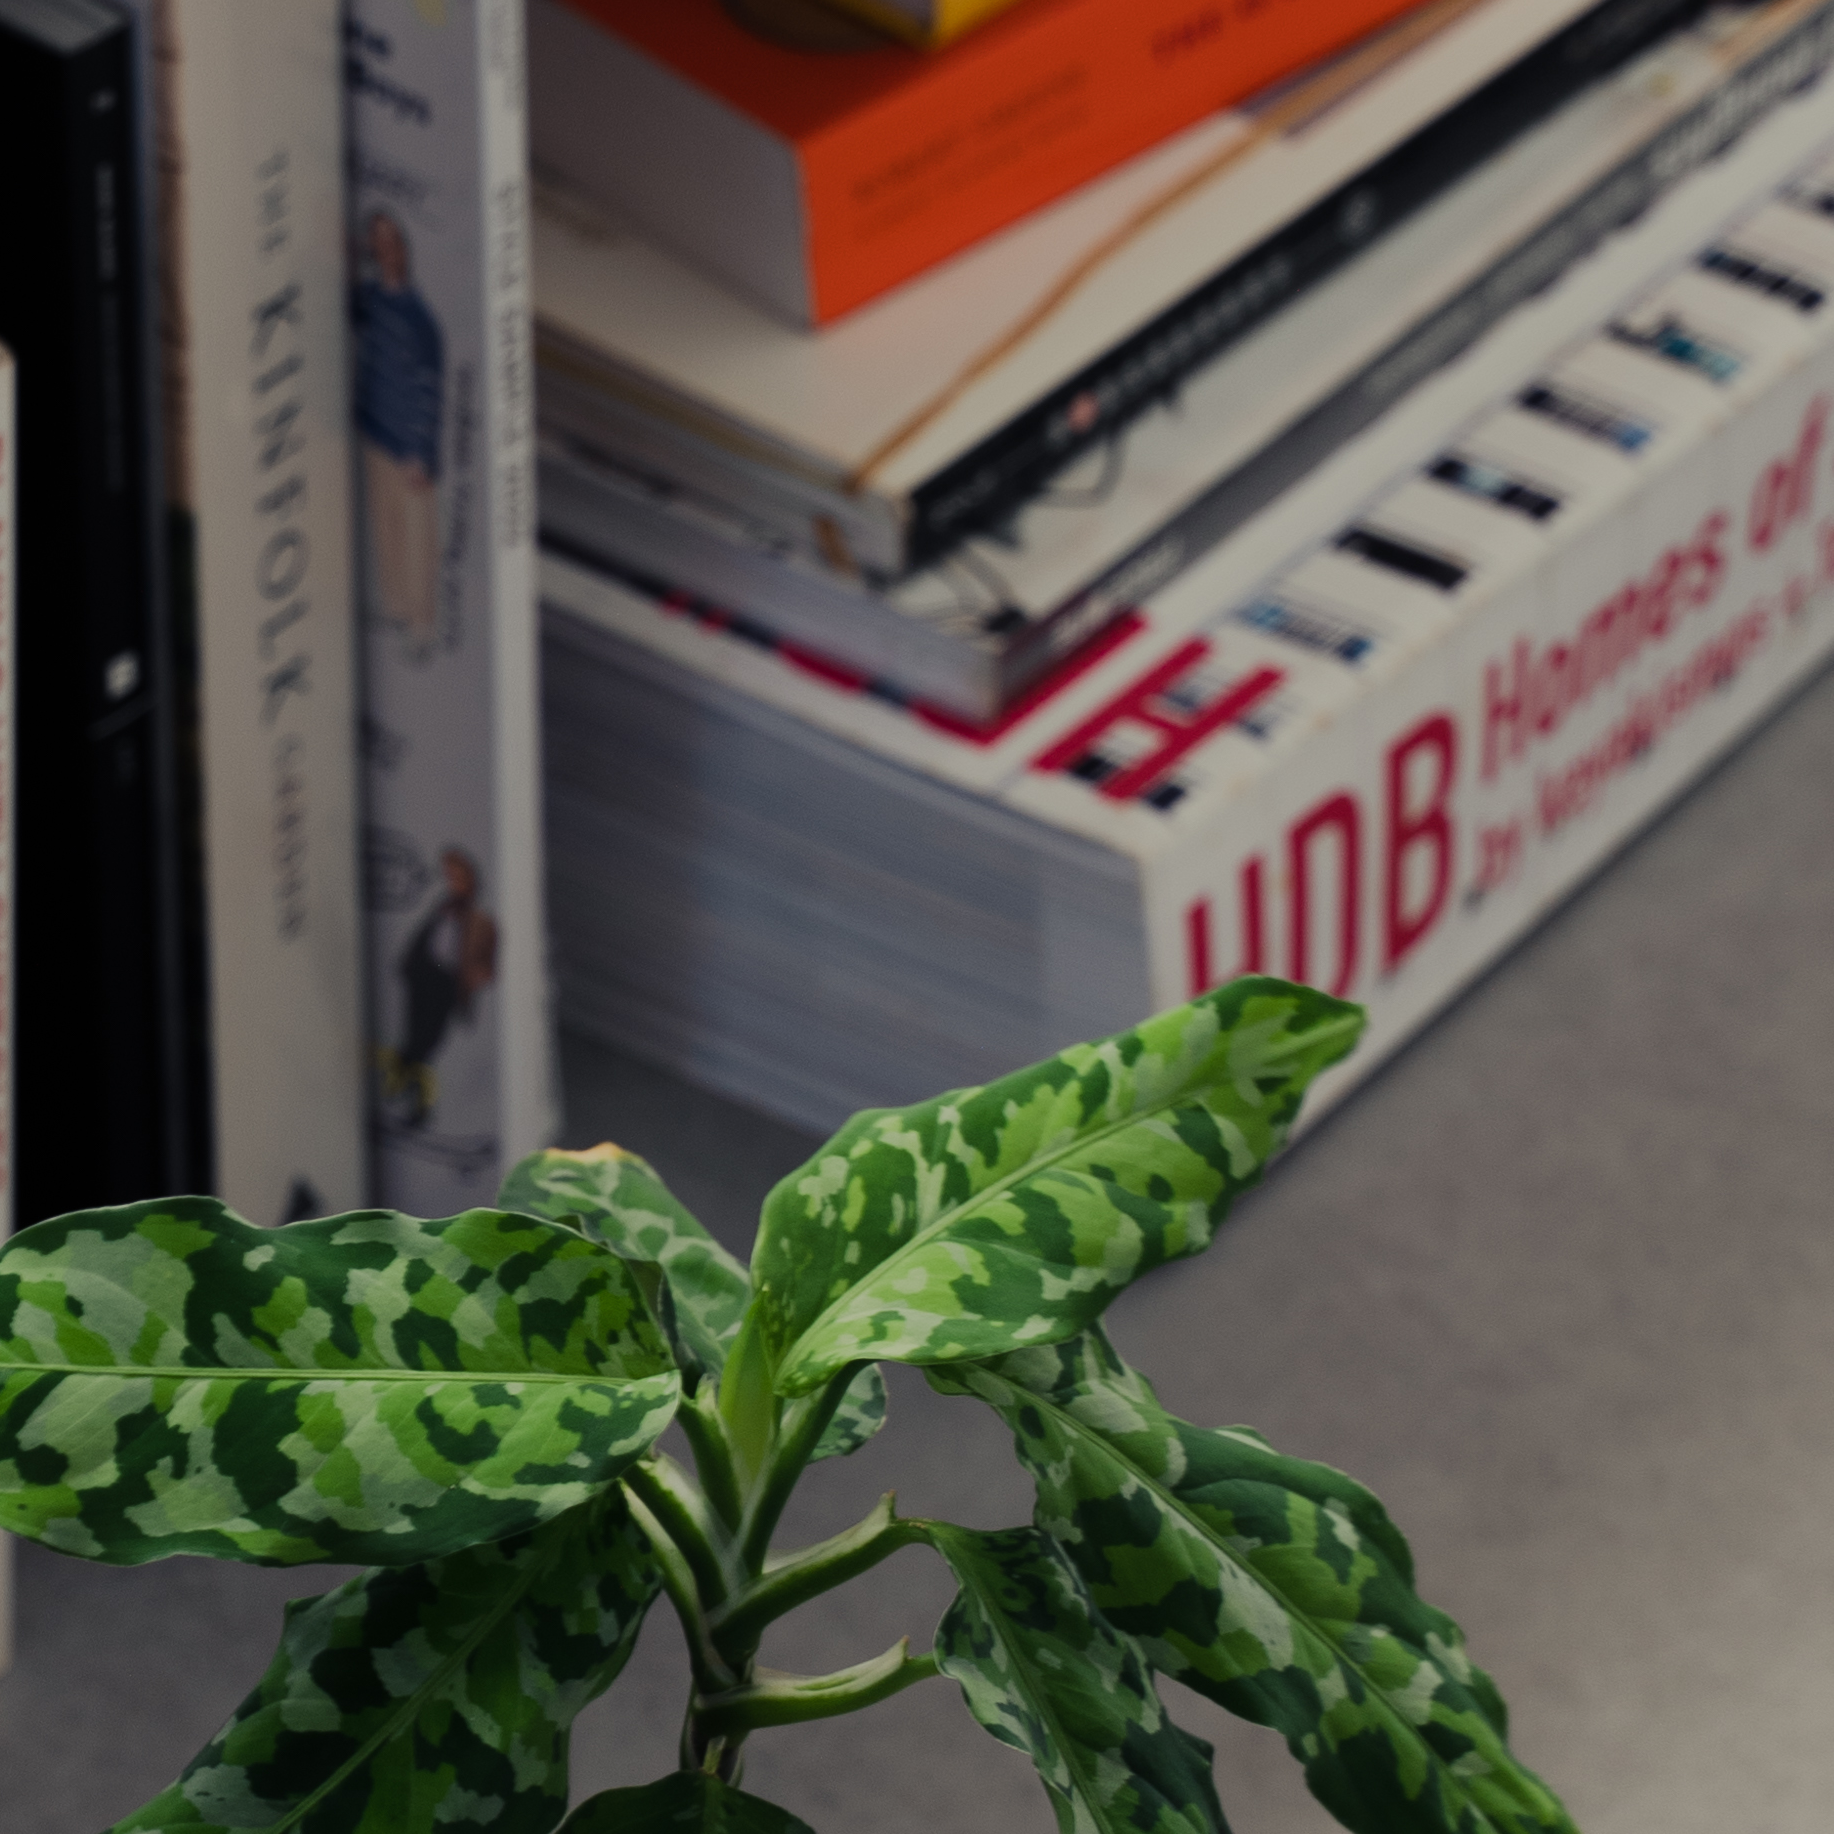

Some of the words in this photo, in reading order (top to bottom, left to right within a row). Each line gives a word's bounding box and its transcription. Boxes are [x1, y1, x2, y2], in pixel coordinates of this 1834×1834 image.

[248, 281, 314, 730] KINFOLK
[1479, 506, 1729, 784] Homes
[1746, 390, 1830, 554] of
[1184, 703, 1459, 1002] HDB
